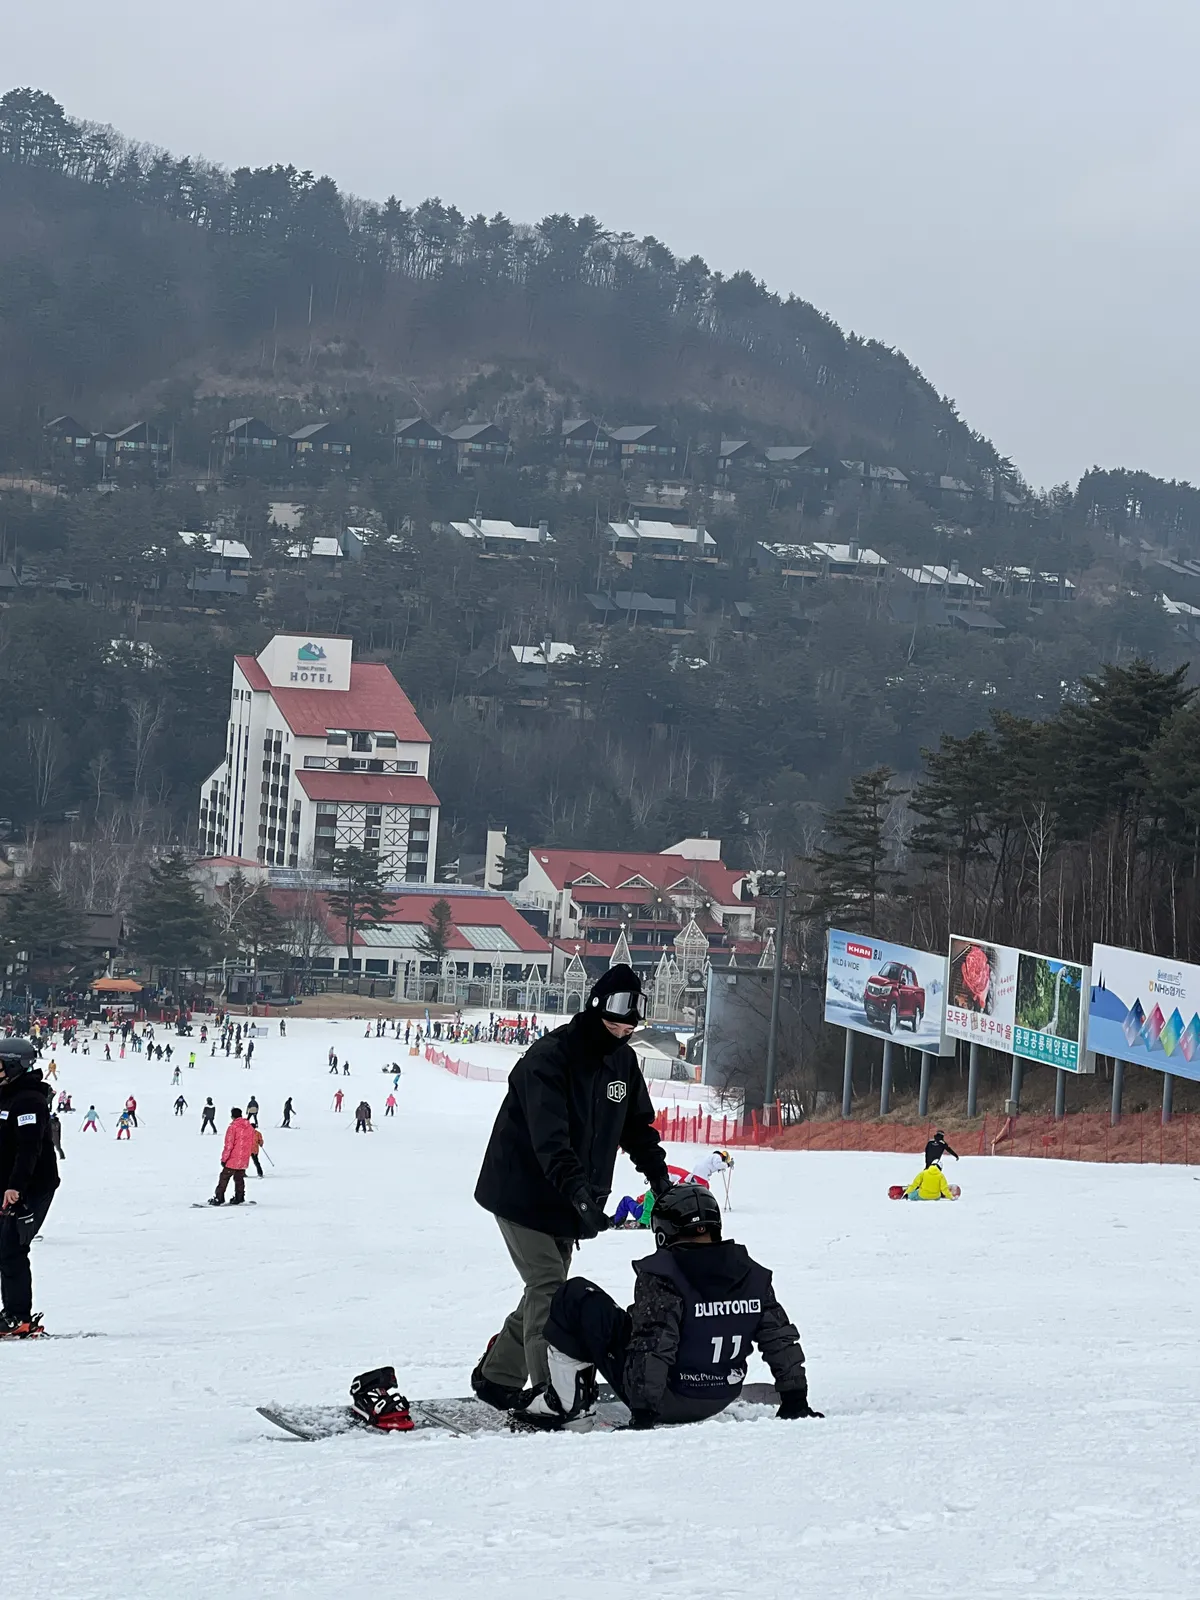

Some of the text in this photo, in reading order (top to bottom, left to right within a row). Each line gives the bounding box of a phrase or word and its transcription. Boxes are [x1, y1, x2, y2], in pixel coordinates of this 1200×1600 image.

[290, 671, 333, 683] HOTEL
[848, 945, 871, 956] KHAN
[832, 957, 844, 967] WILD
[848, 962, 860, 971] WIDE
[947, 1010, 968, 1028] 모두랑
[981, 1017, 1012, 1040] 한우마을
[694, 1300, 749, 1318] BURTON
[711, 1335, 742, 1364] 11
